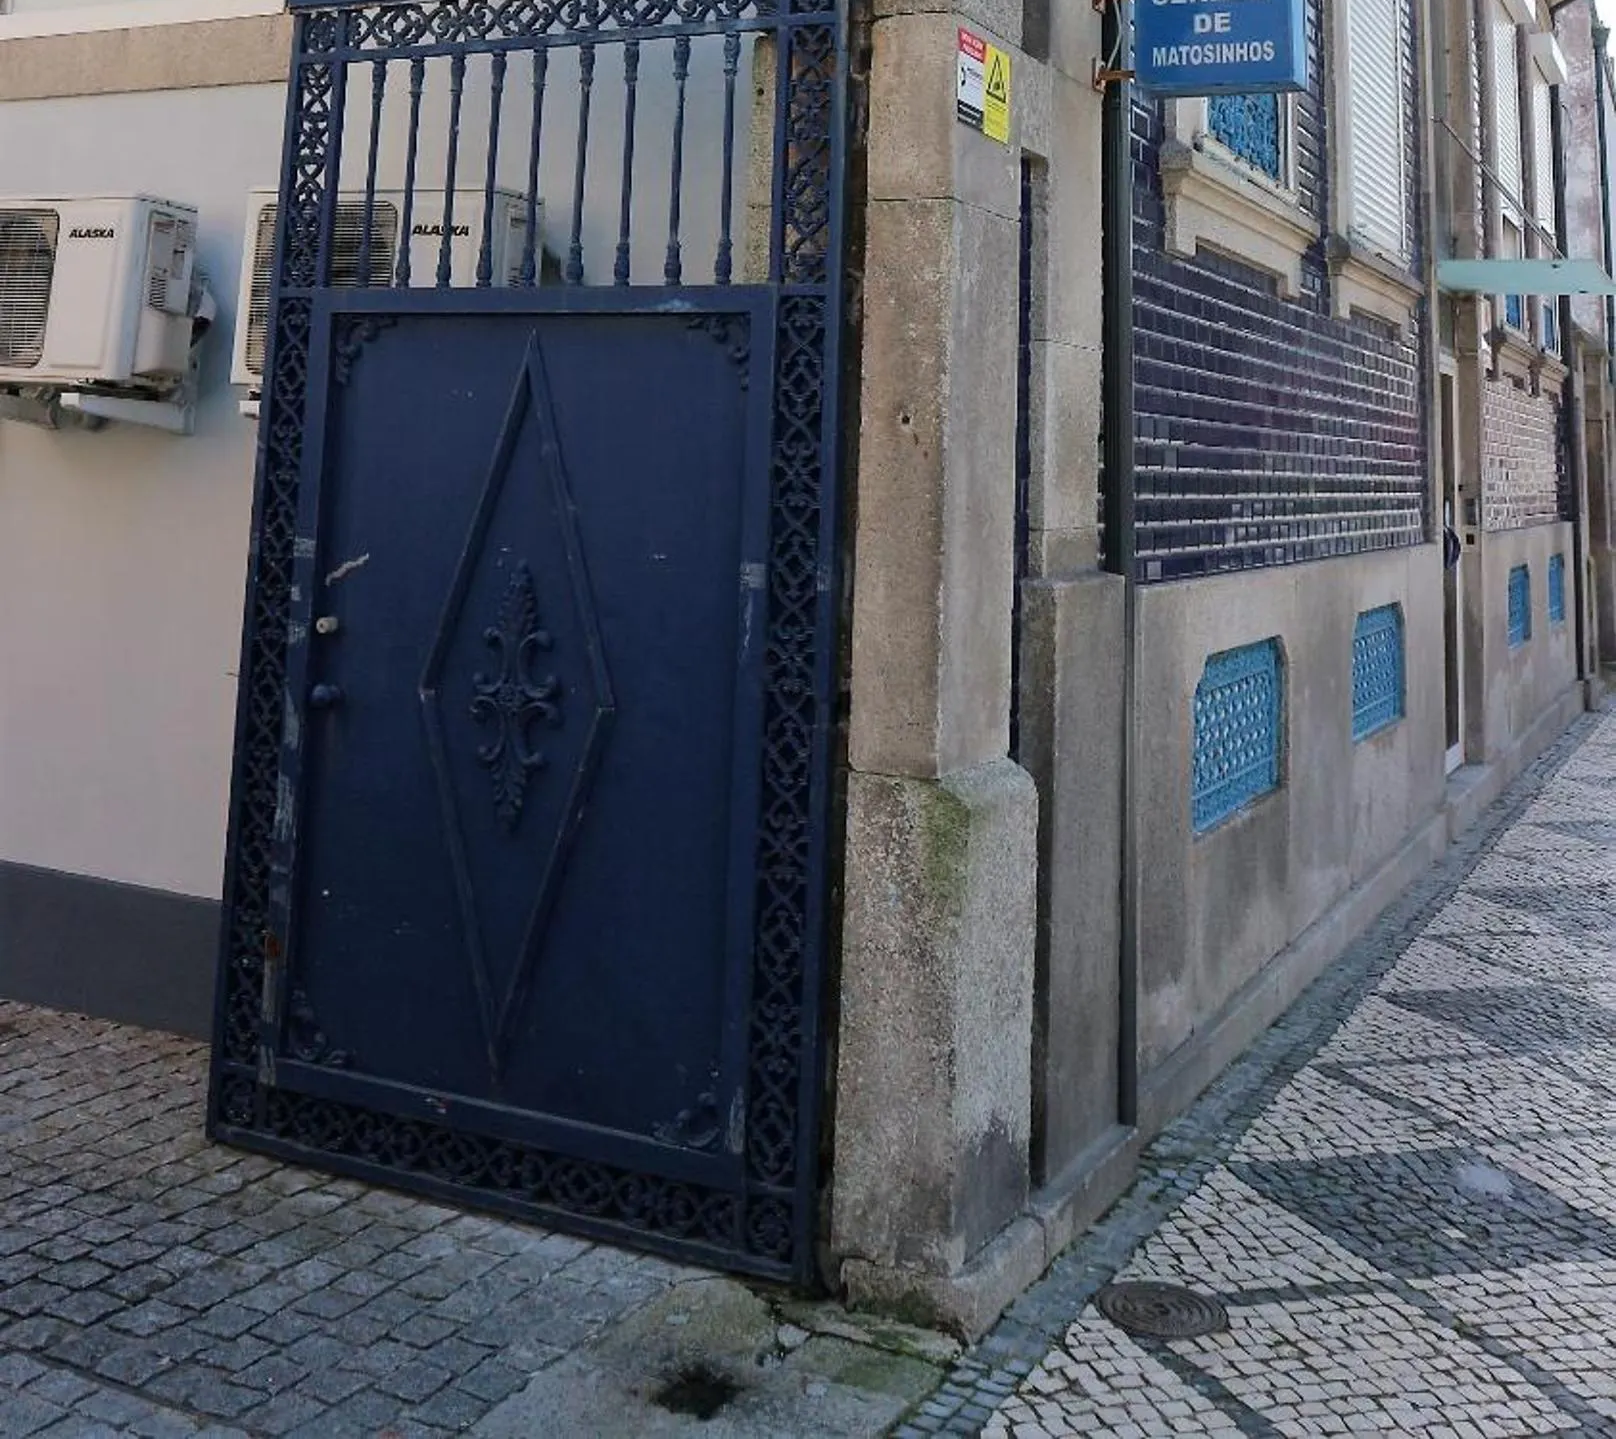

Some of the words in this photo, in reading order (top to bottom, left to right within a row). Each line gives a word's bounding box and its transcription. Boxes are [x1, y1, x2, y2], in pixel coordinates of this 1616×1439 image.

[1193, 11, 1232, 34] DE
[1152, 39, 1276, 68] MATOSINHOS
[68, 228, 115, 239] ALASKA
[412, 224, 470, 237] ALAKA
